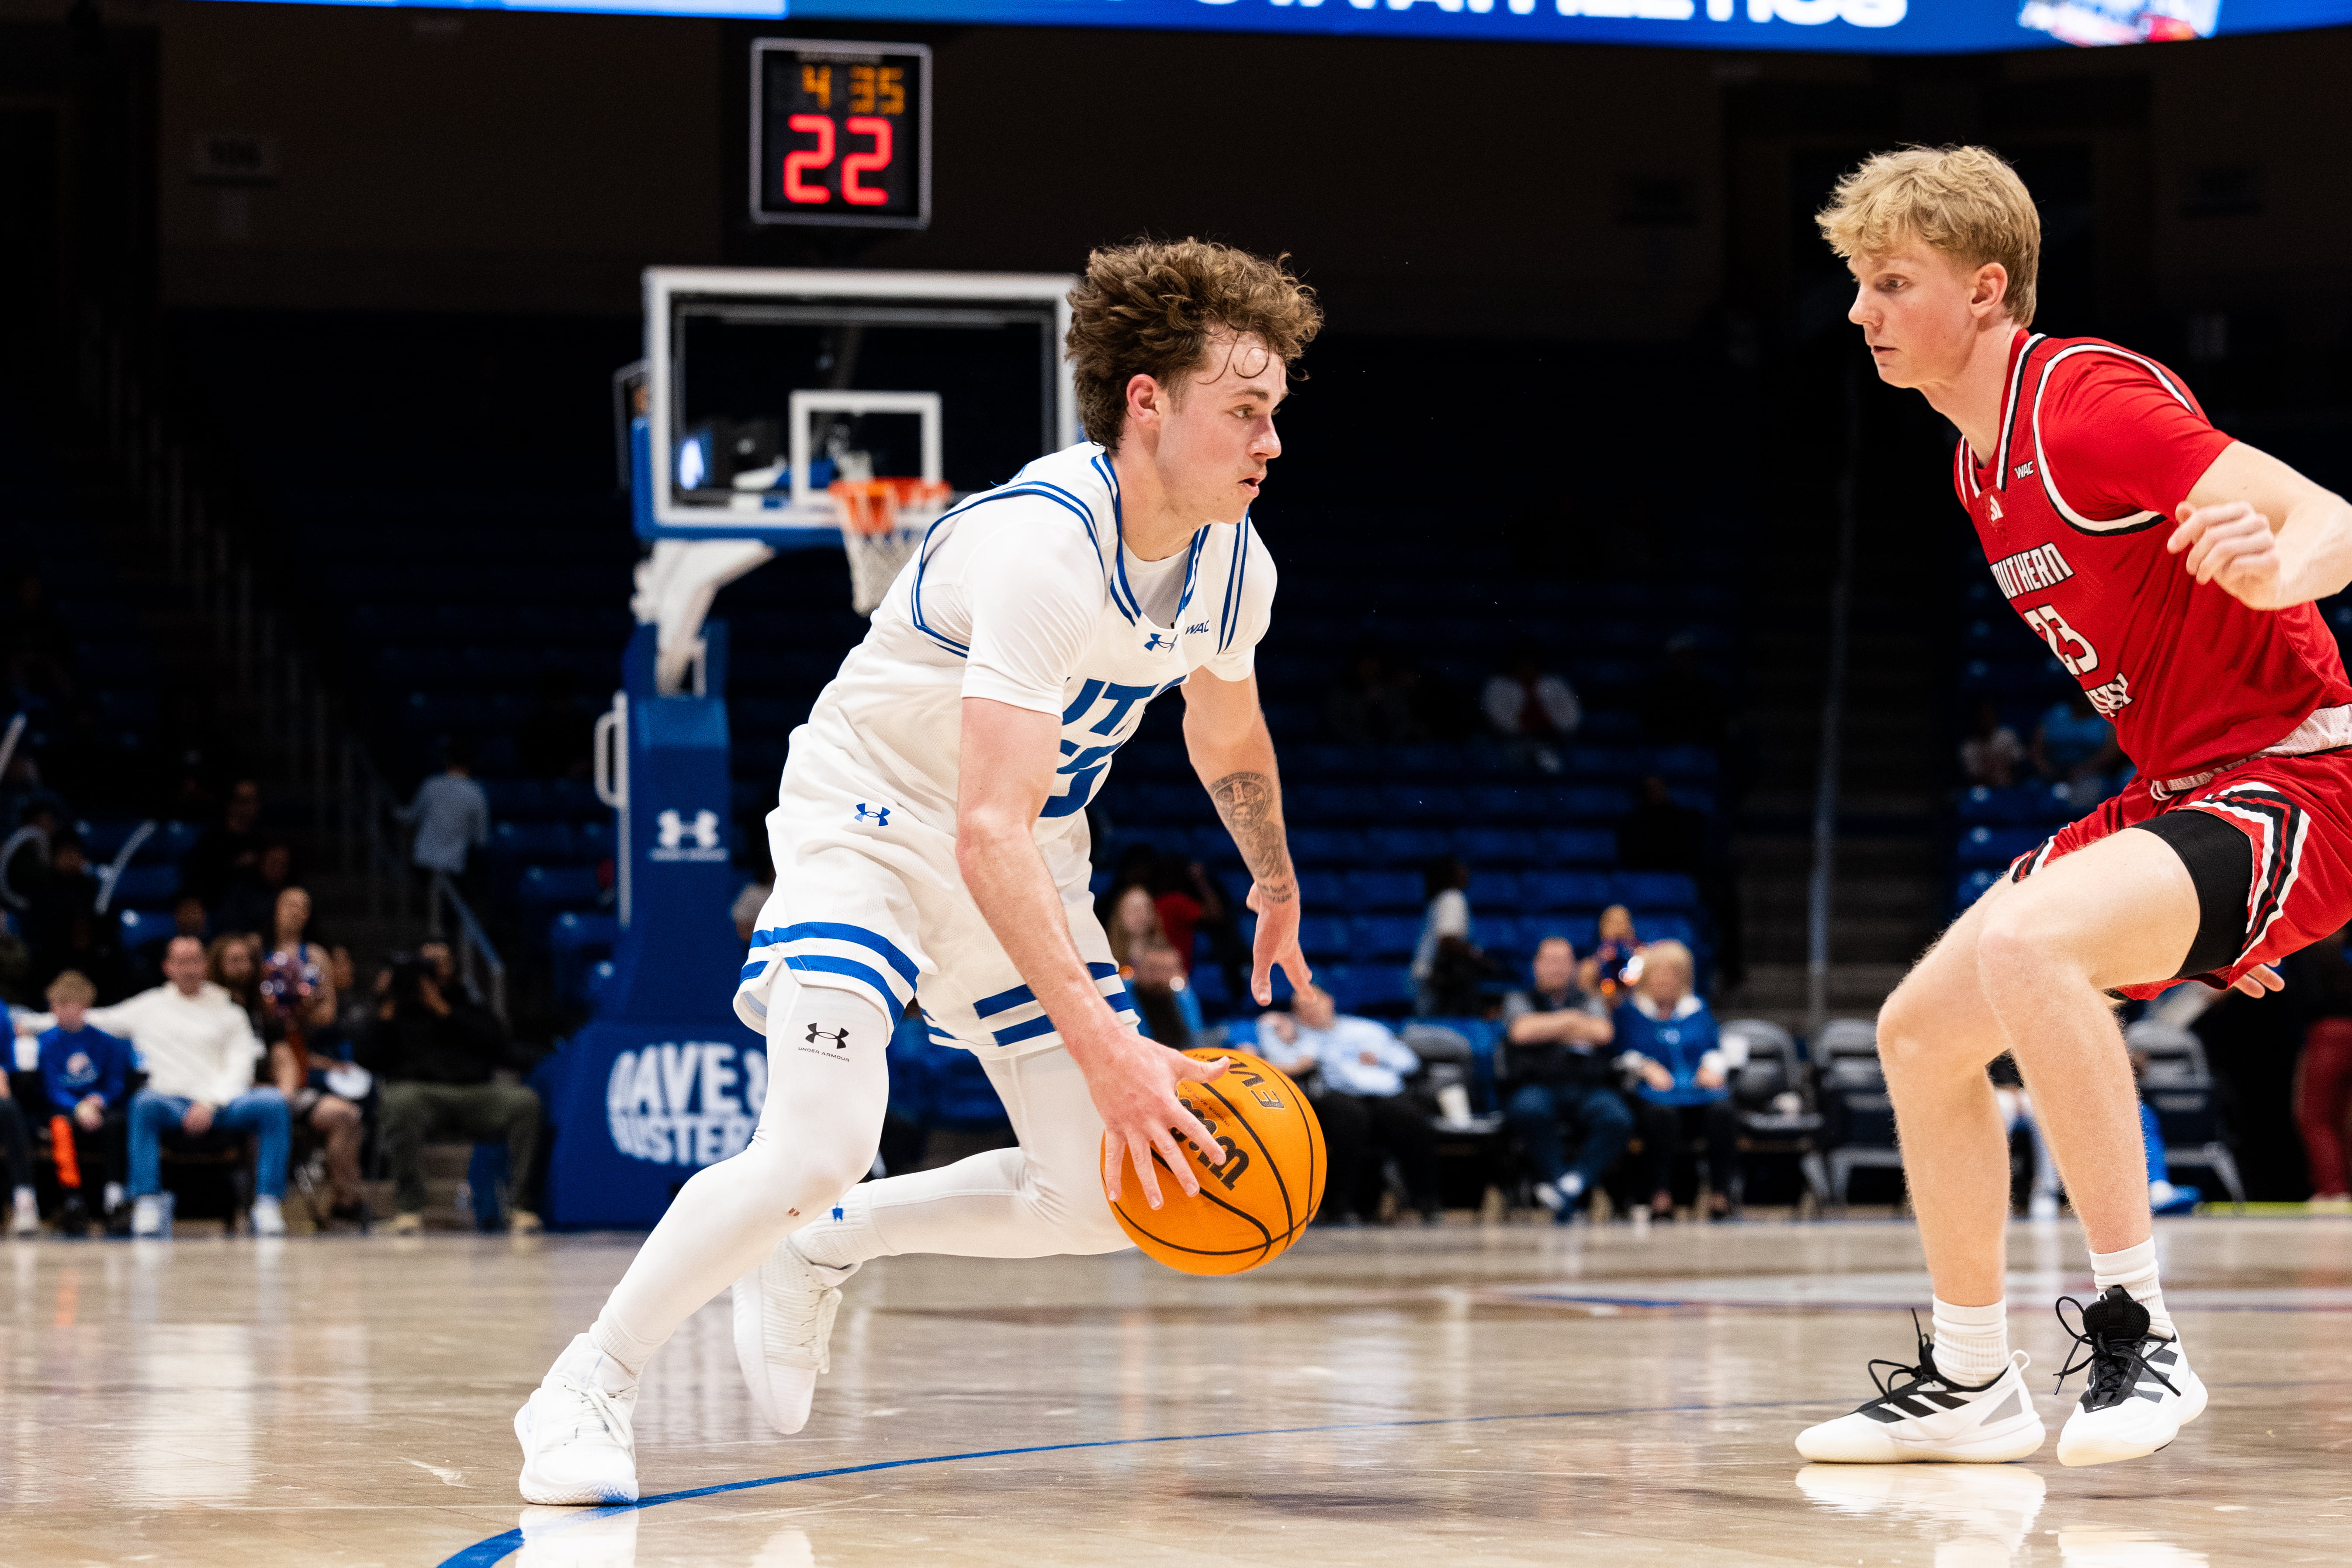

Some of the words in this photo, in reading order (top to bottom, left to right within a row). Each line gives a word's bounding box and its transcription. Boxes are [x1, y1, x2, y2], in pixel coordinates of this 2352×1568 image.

[802, 65, 831, 110] 4
[849, 66, 905, 114] 35
[783, 114, 893, 205] 22
[2013, 460, 2034, 480] WAC
[1990, 541, 2076, 600] OUTHERN
[1185, 619, 1209, 635] WAC
[2023, 603, 2099, 677] 23
[821, 1052, 850, 1062] ARMOUR
